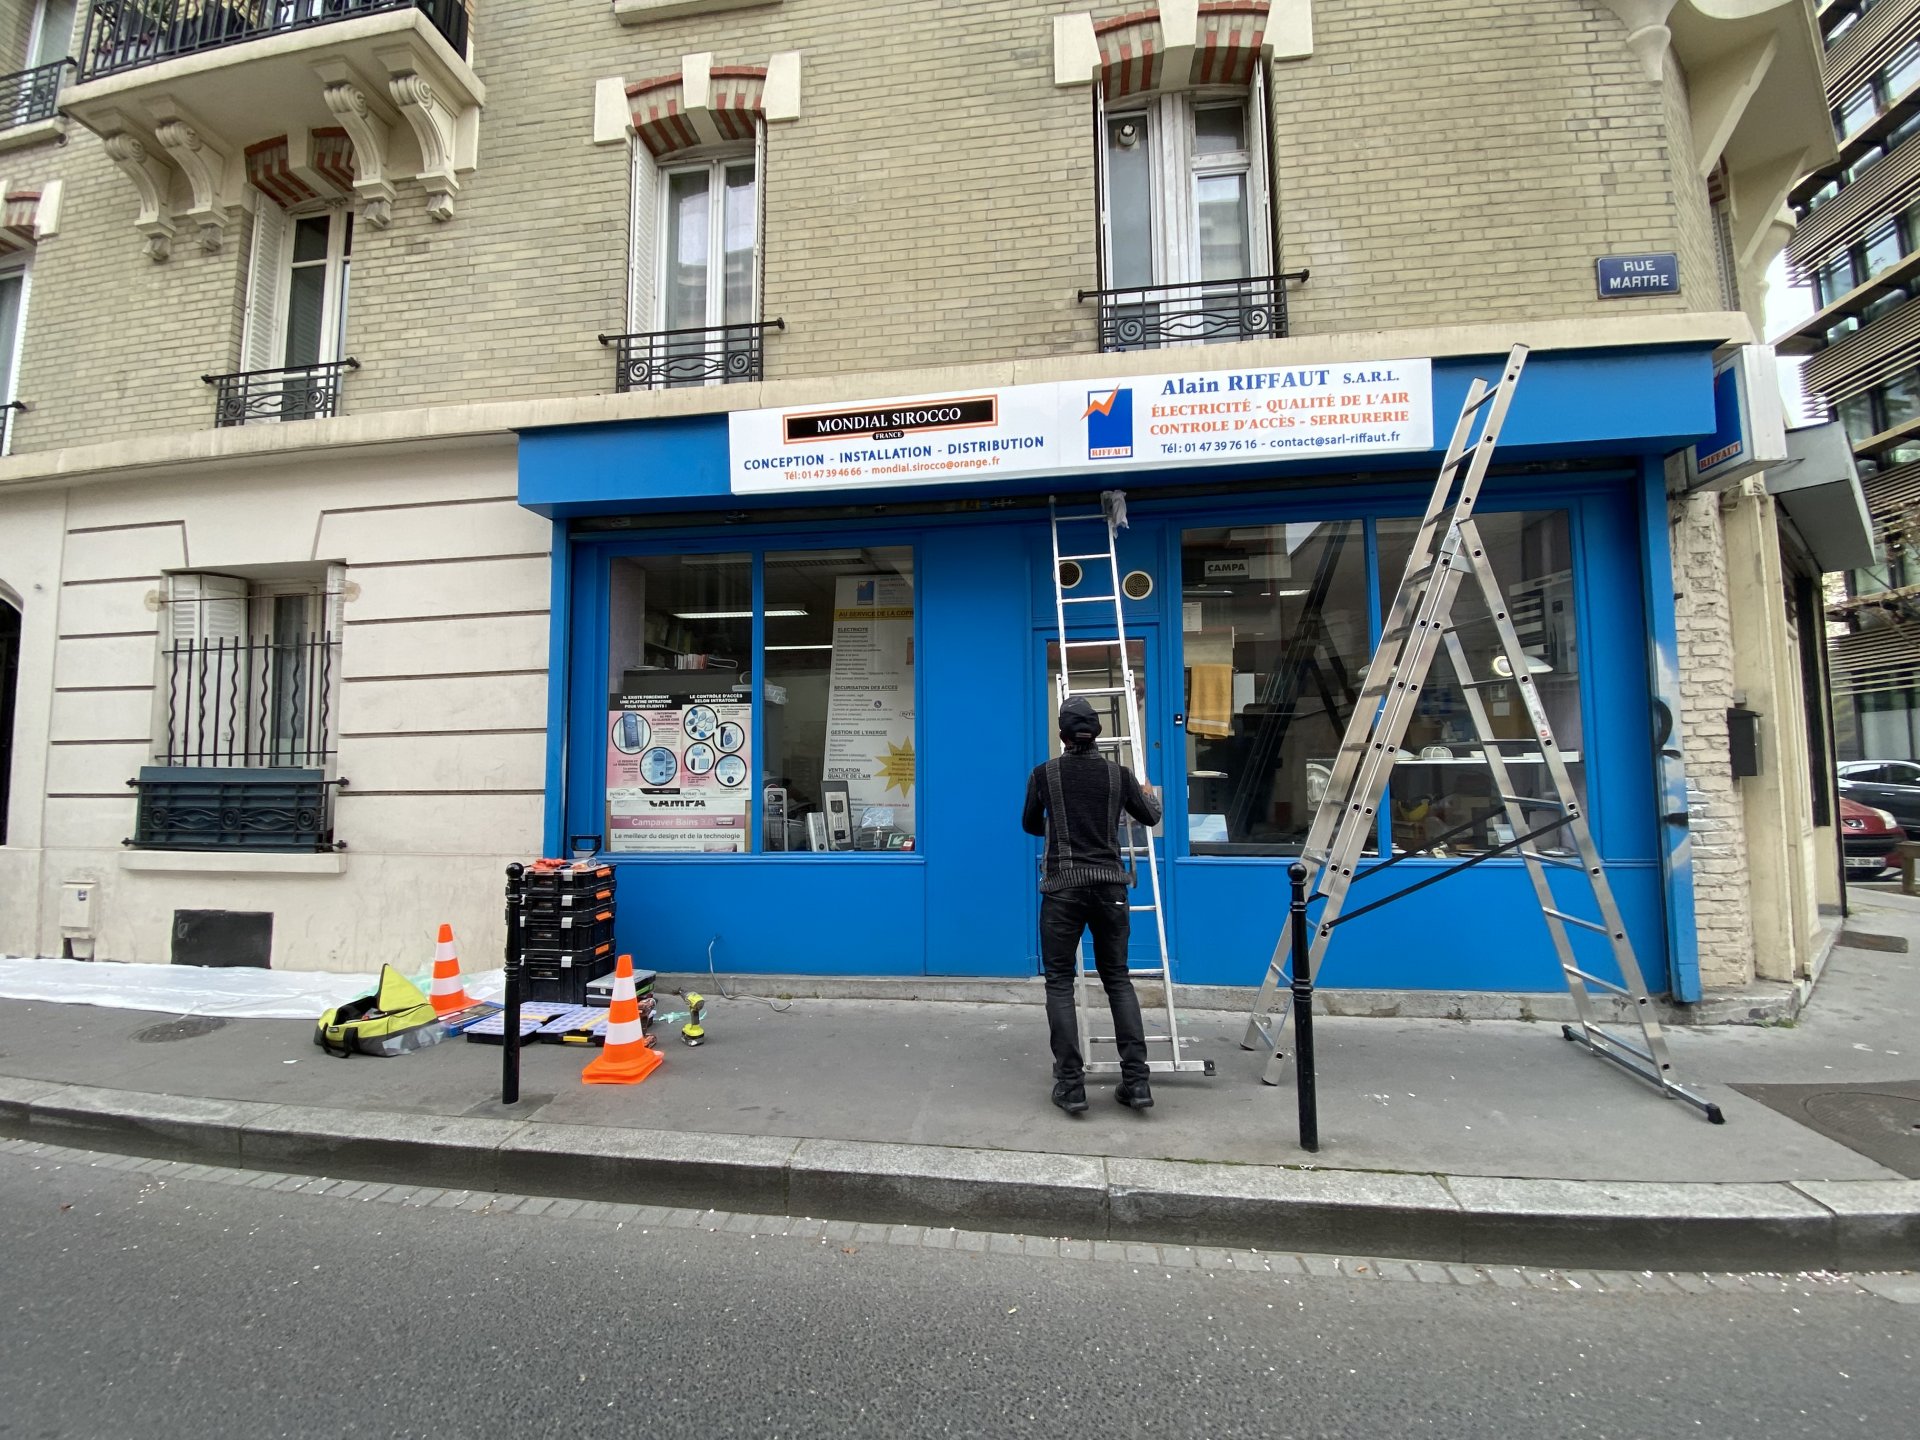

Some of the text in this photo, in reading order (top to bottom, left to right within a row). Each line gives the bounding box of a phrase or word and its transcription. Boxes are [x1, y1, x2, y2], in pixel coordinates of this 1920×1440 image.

[1623, 260, 1656, 272] RUE
[1609, 274, 1670, 289] MARTRE
[1161, 369, 1400, 396] Alain RIFFAUT S.A.R.L.
[1151, 398, 1252, 418] ÉLECTRICITÉ
[1266, 393, 1336, 413] QUALITÉ
[1340, 394, 1361, 407] DE
[1366, 392, 1410, 406] L'AIR
[817, 407, 961, 433] MONDIAL SIROCCO
[1150, 420, 1230, 436] CONTROLE
[1234, 413, 1296, 432] D'ACCÈS
[1310, 410, 1409, 427] SERRURERIE
[875, 431, 902, 440] FRANCE
[1270, 431, 1401, 448] contact@sarl-riffaut.fr
[744, 453, 825, 471] CONCEPTION
[839, 445, 932, 463] INSTALLATION
[948, 436, 1044, 455] DISTRIBUTION
[1091, 447, 1130, 457] RIFFAUT
[1700, 443, 1739, 469] RIFFAUT
[871, 456, 1001, 474] mondial.sirocco@orange.fr
[1207, 563, 1246, 572] CAMPA
[631, 818, 673, 828] Campaver
[675, 818, 699, 826] Bains
[657, 833, 679, 841] design
[703, 832, 741, 841] technologie
